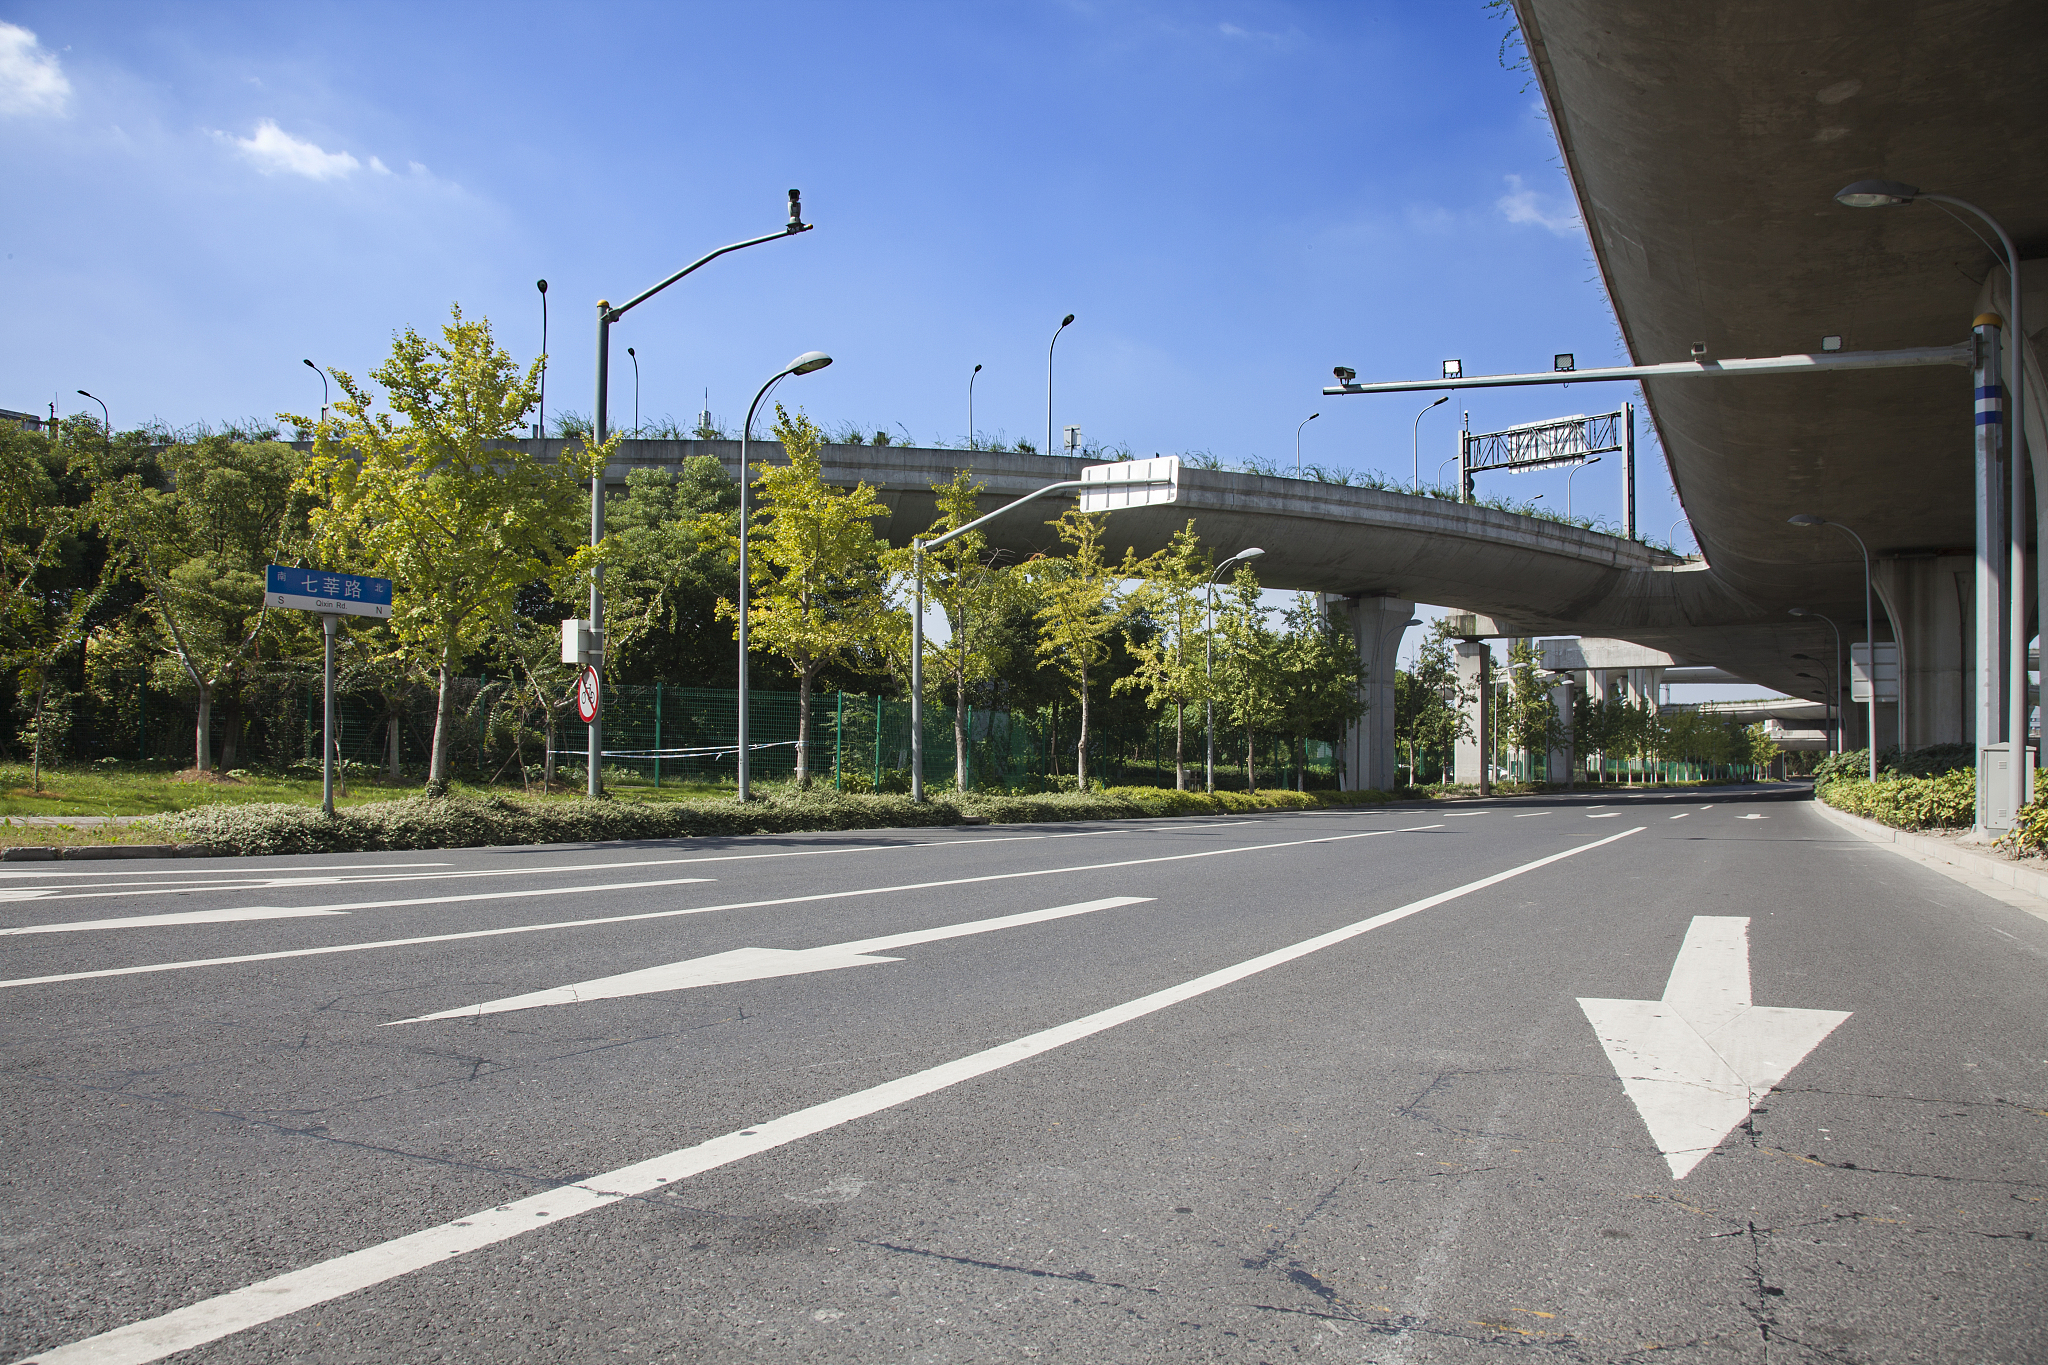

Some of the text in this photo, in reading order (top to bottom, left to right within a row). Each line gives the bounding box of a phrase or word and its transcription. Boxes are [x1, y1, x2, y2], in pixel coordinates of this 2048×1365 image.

[277, 571, 286, 581] 南
[301, 575, 362, 598] 七莘路
[374, 583, 383, 593] 北
[277, 595, 285, 604] S
[315, 599, 348, 609] Qixin Rd.
[375, 606, 383, 615] N
